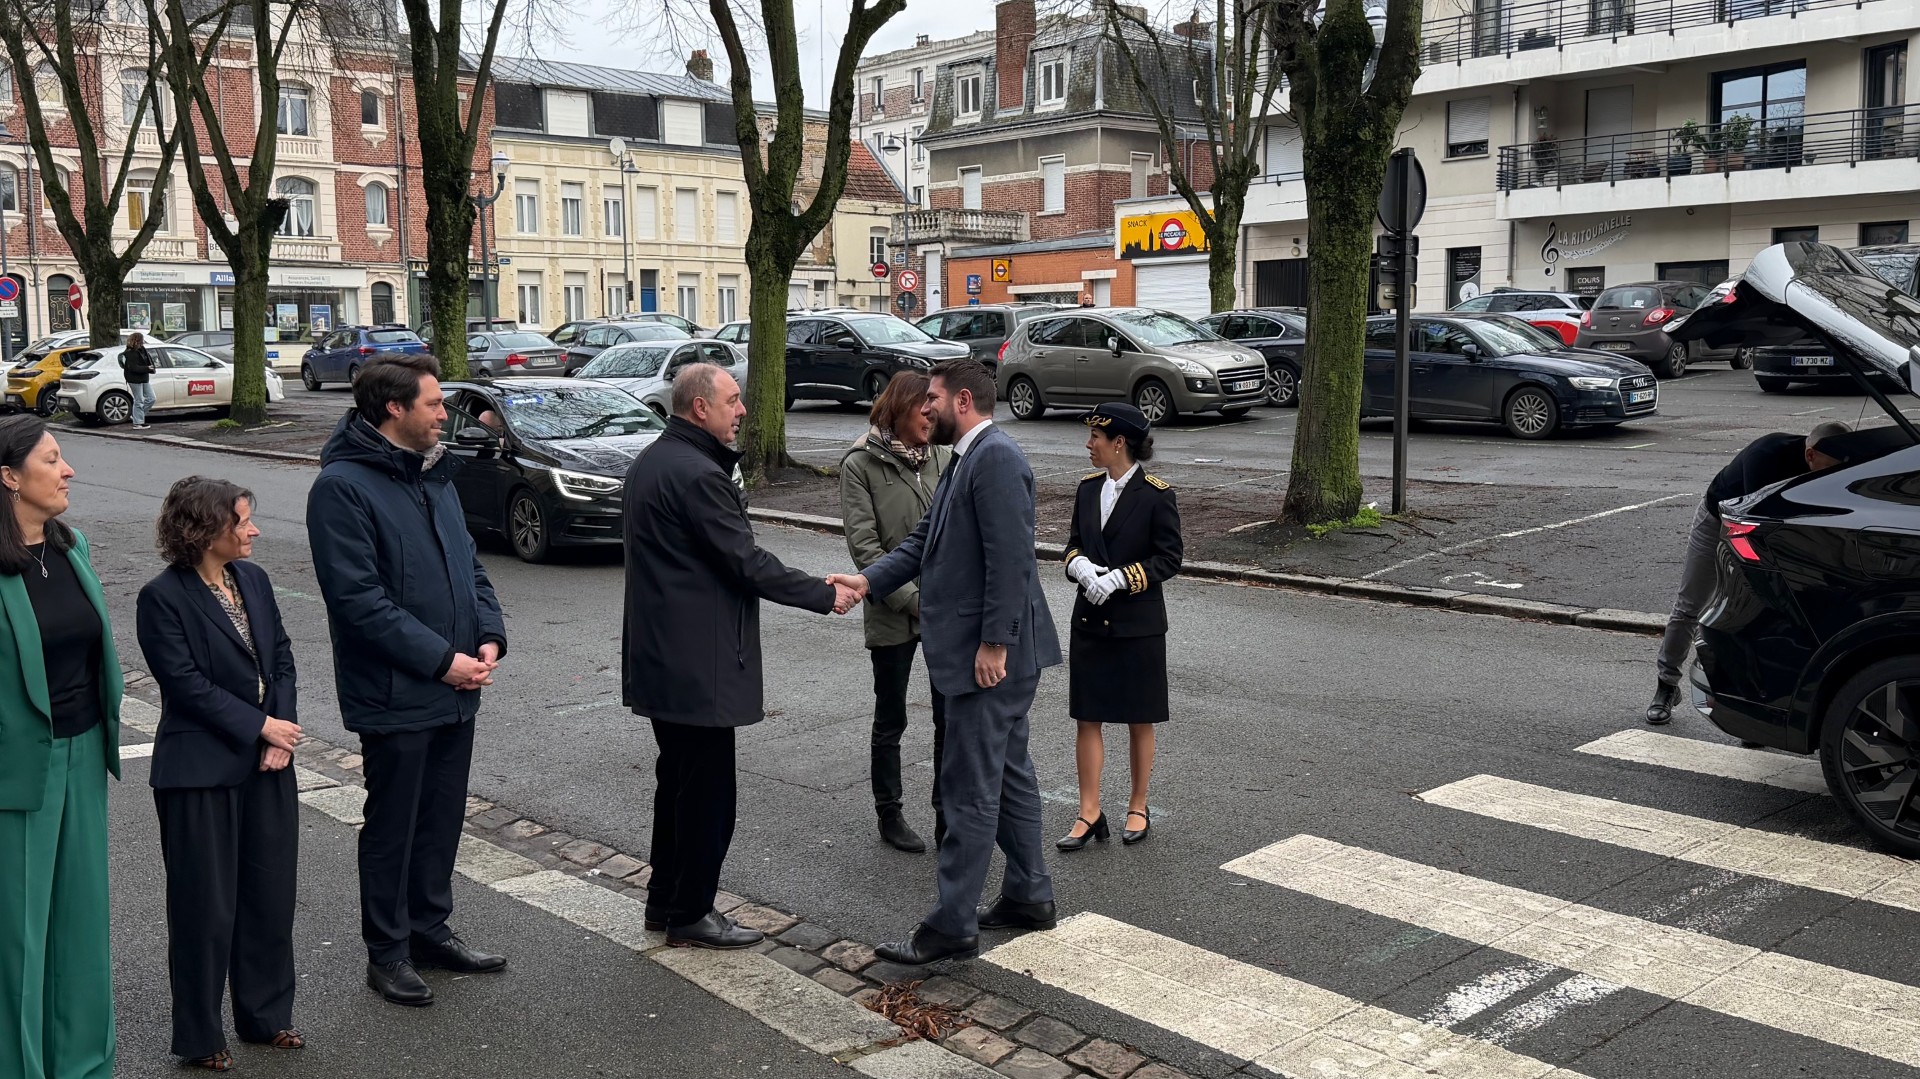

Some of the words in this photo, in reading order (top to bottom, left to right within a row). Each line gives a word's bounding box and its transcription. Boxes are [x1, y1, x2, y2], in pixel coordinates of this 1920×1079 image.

[1127, 219, 1148, 228] SNACK
[1558, 229, 1569, 246] LA
[1571, 215, 1632, 246] RITOURNELLE
[411, 262, 430, 272] LIV
[215, 274, 236, 282] Allia
[1806, 357, 1818, 365] 730
[191, 382, 214, 392] Aisne
